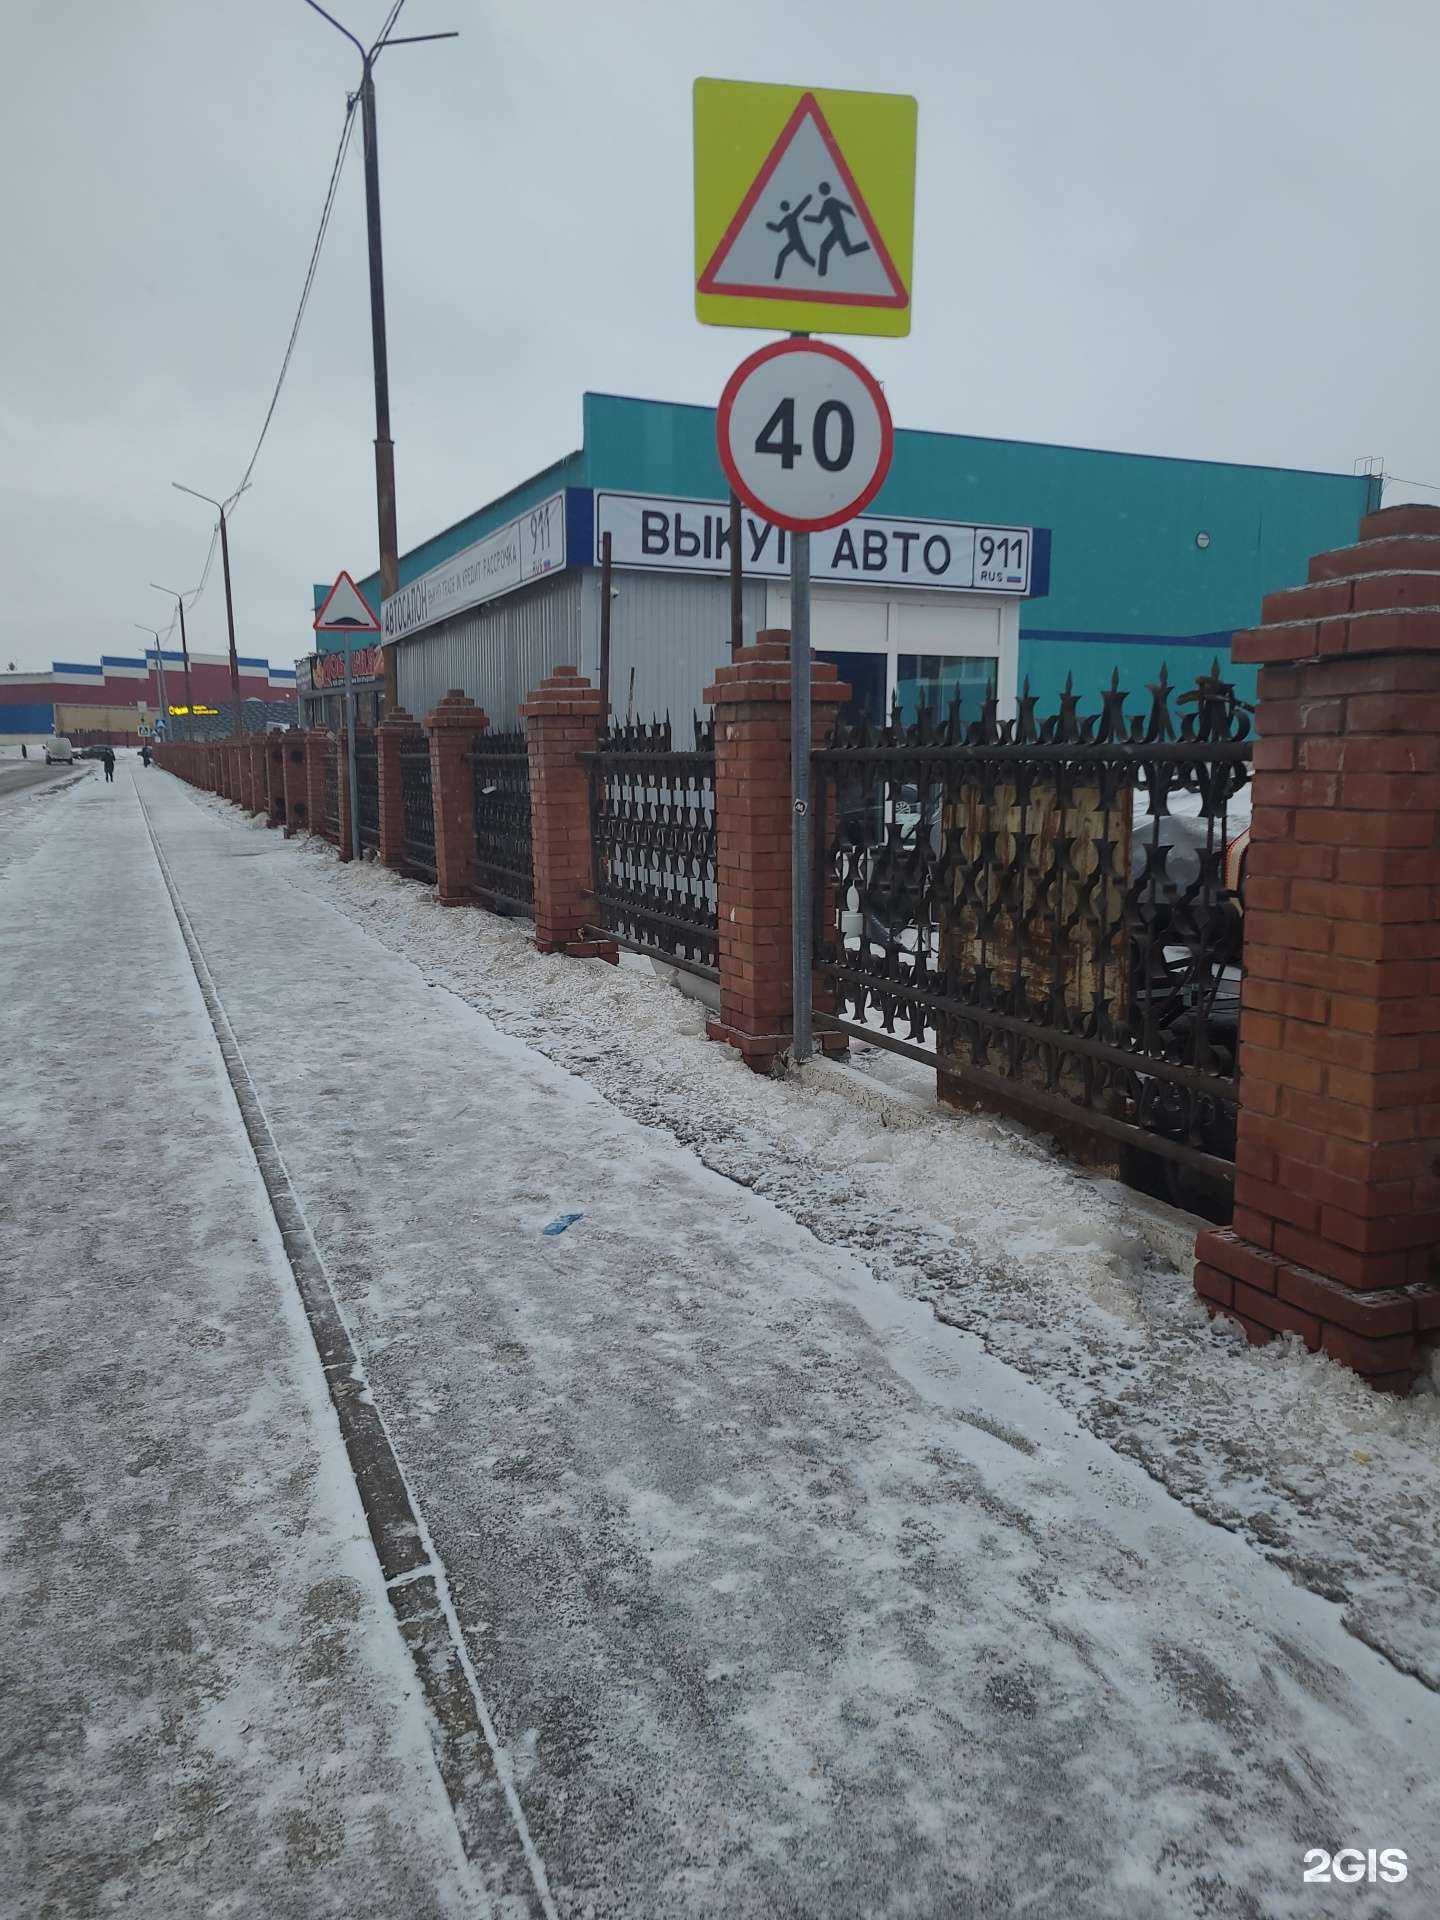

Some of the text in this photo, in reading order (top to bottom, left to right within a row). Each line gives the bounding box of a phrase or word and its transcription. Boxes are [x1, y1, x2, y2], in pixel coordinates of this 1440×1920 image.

[754, 397, 854, 472] 40
[530, 506, 550, 554] 911
[641, 510, 951, 575] ВЫКУ АВТО
[979, 535, 1023, 569] 911
[980, 570, 1004, 583] RUS
[385, 583, 428, 636] АВТОСАЛОН
